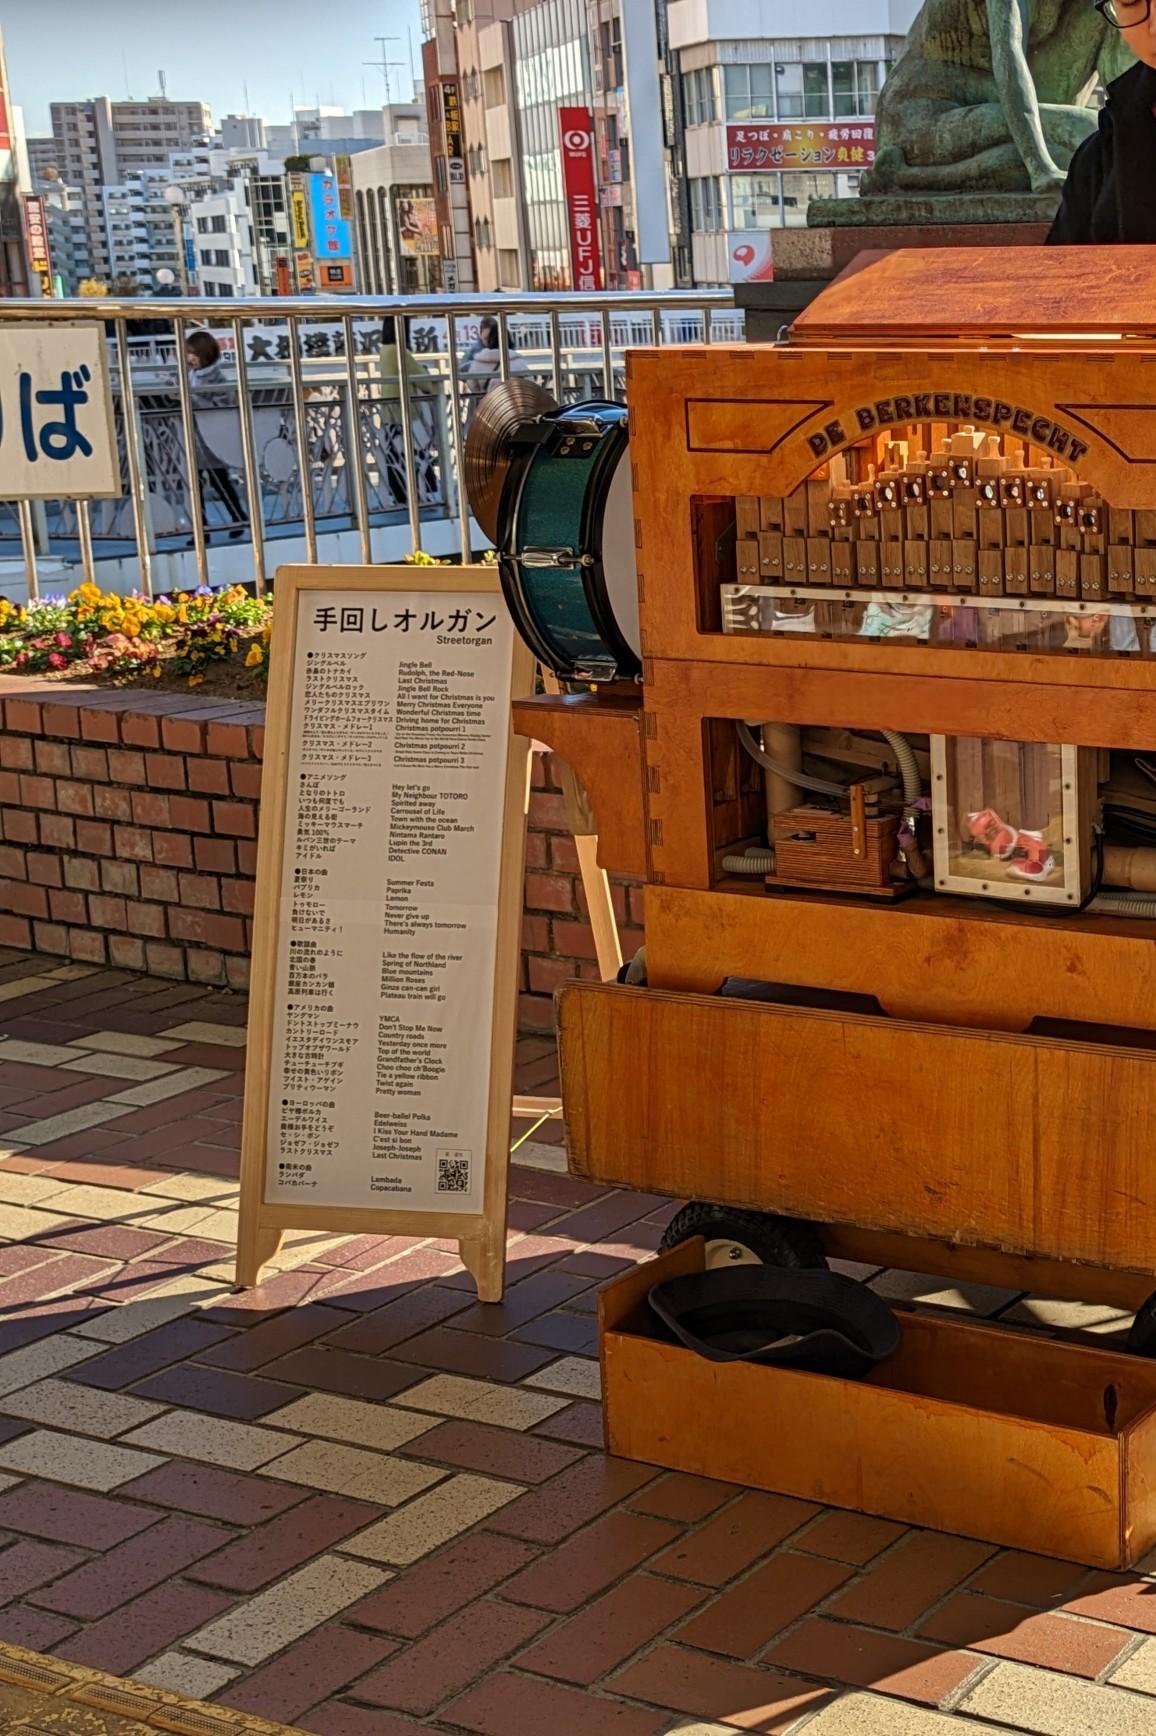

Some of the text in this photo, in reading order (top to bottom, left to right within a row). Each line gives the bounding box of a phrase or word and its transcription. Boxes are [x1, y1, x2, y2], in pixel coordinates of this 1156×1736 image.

[807, 391, 1089, 463] DE BERKENSPECHT
[313, 606, 497, 633] 手回しオルガン
[436, 635, 493, 646] Streetorgan
[452, 702, 482, 710] Everyone
[386, 887, 411, 895] Paprika
